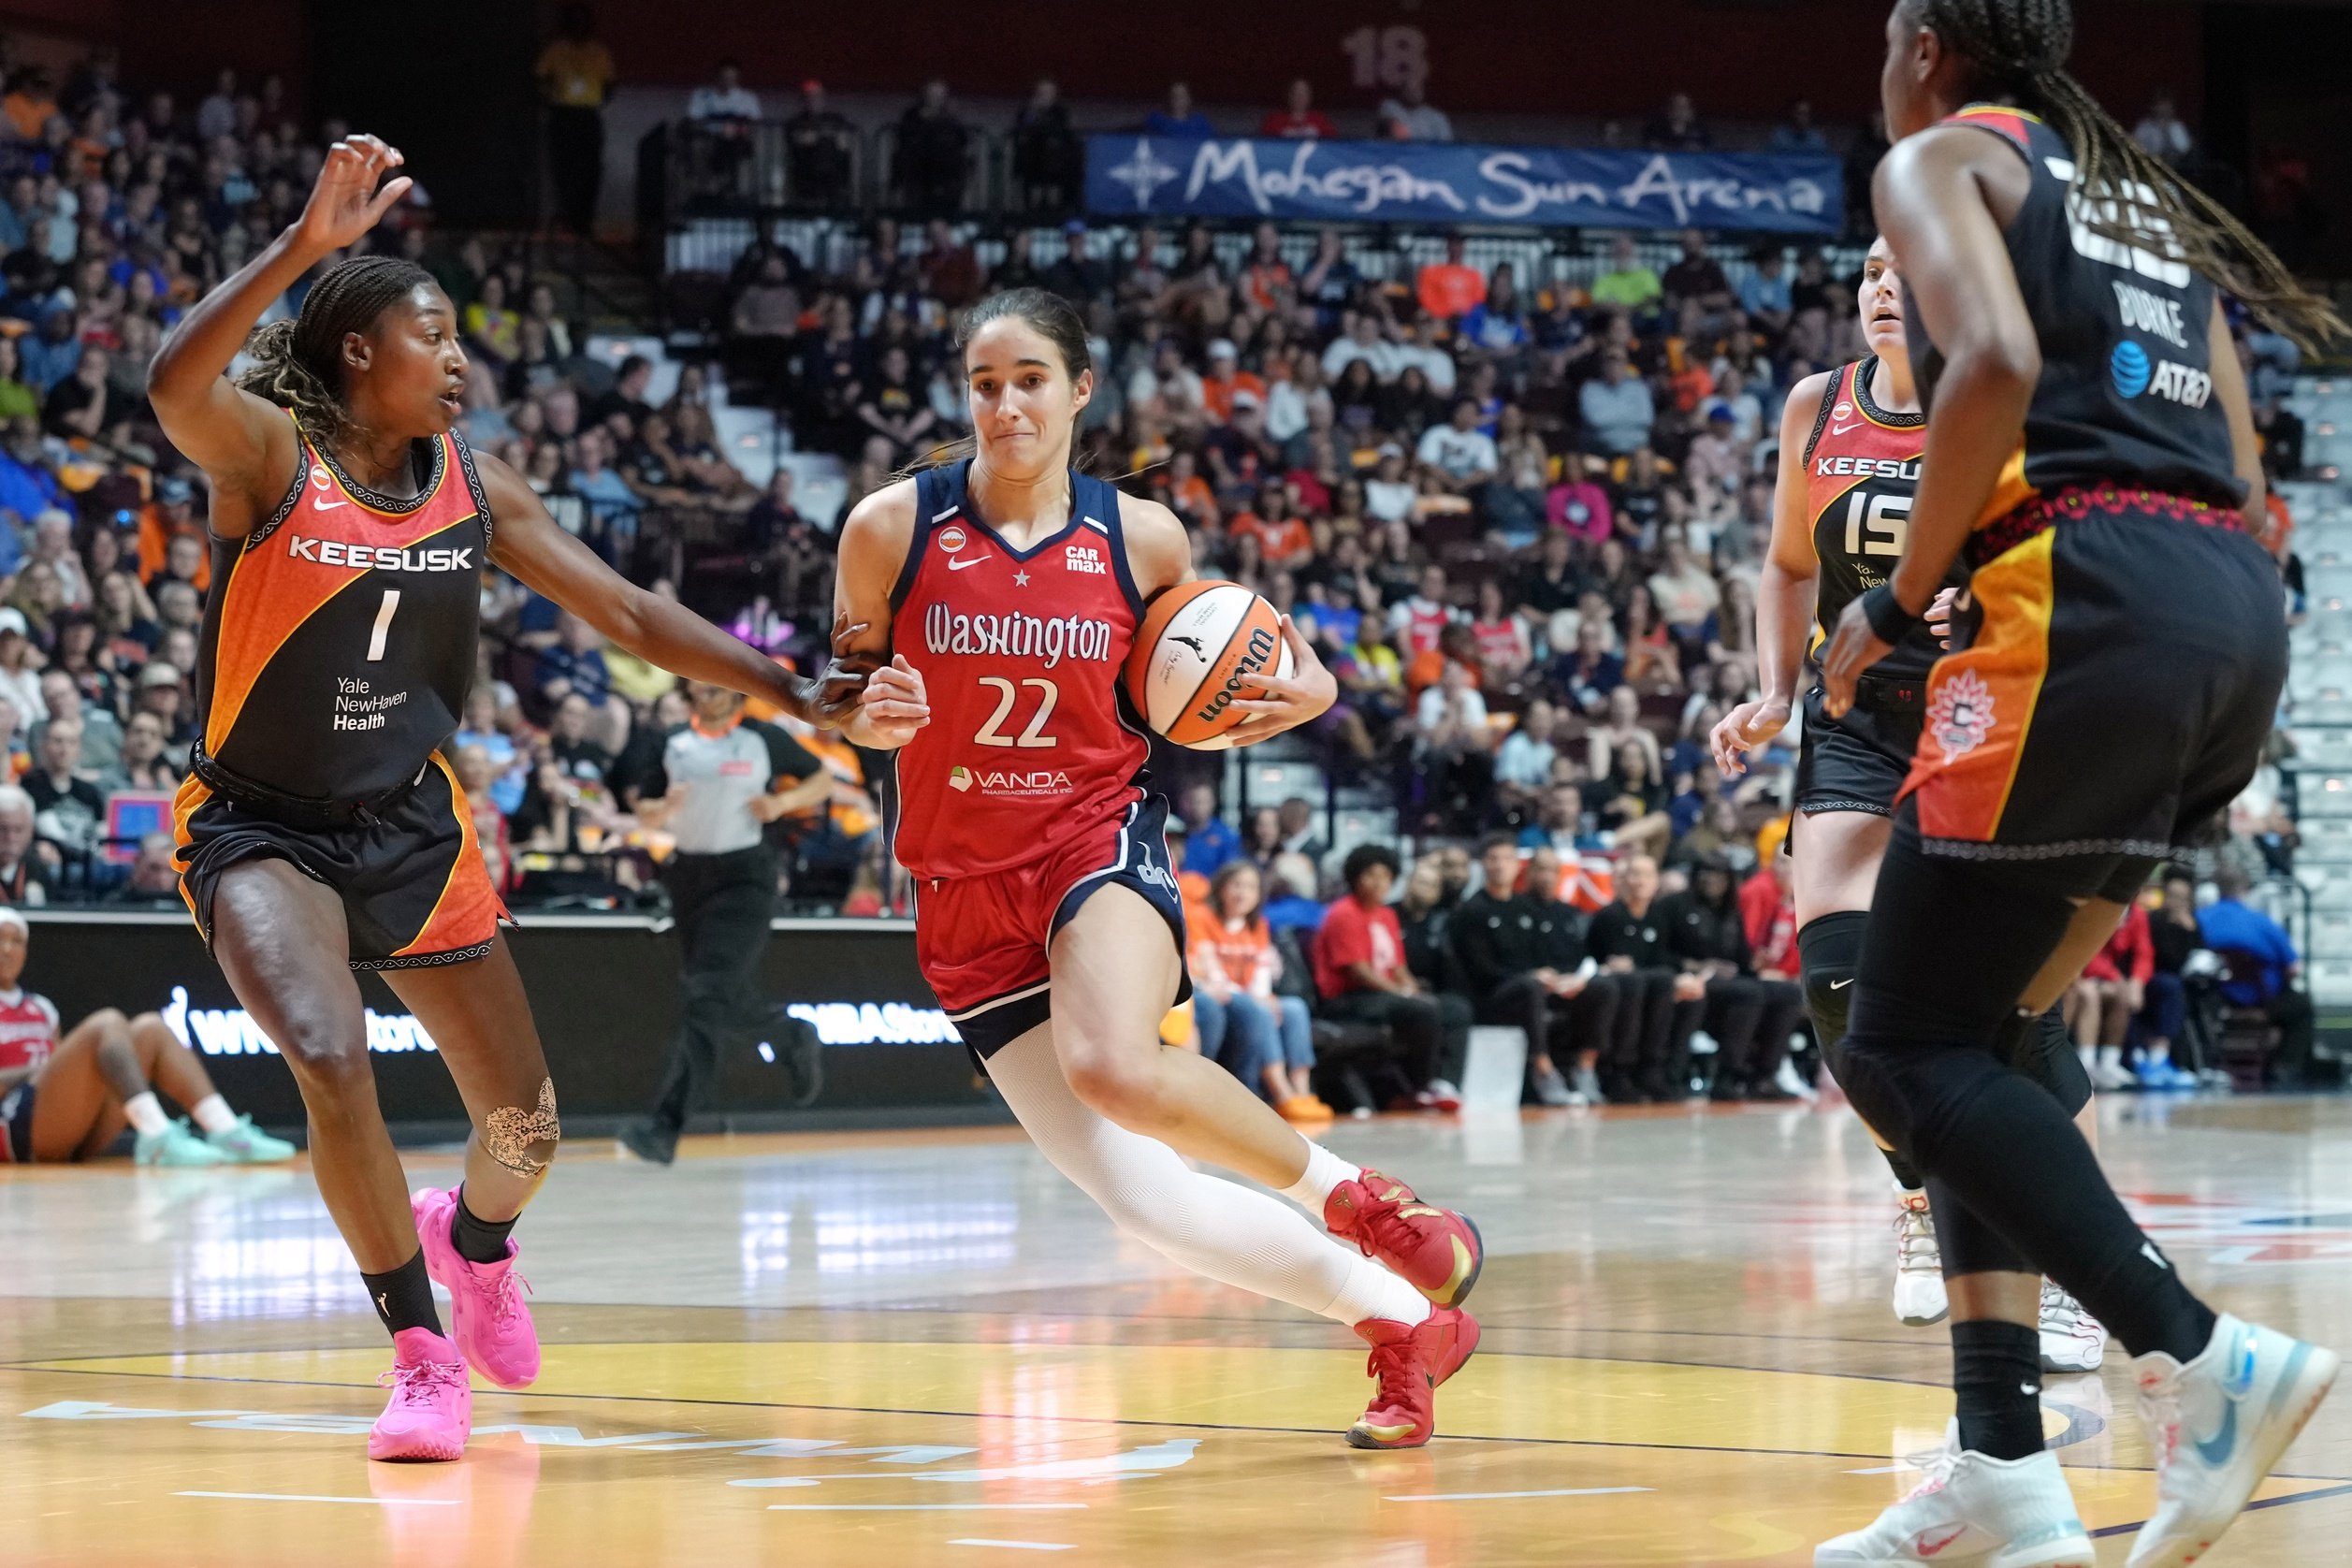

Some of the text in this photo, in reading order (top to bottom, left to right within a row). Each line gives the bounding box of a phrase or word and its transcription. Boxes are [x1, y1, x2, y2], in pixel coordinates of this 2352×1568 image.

[1184, 138, 1826, 225] Mohegan Sun Arena
[1817, 457, 1923, 481] KEESU
[1845, 491, 1913, 557] 15
[288, 534, 473, 573] KEESUSK
[1065, 545, 1098, 561] CAR
[1067, 558, 1107, 575] max
[367, 589, 401, 661] 1
[924, 602, 1111, 670] Washington
[337, 676, 370, 694] Yale
[333, 713, 385, 732] Health
[974, 675, 1059, 748] 22
[974, 771, 1073, 789] VANDA
